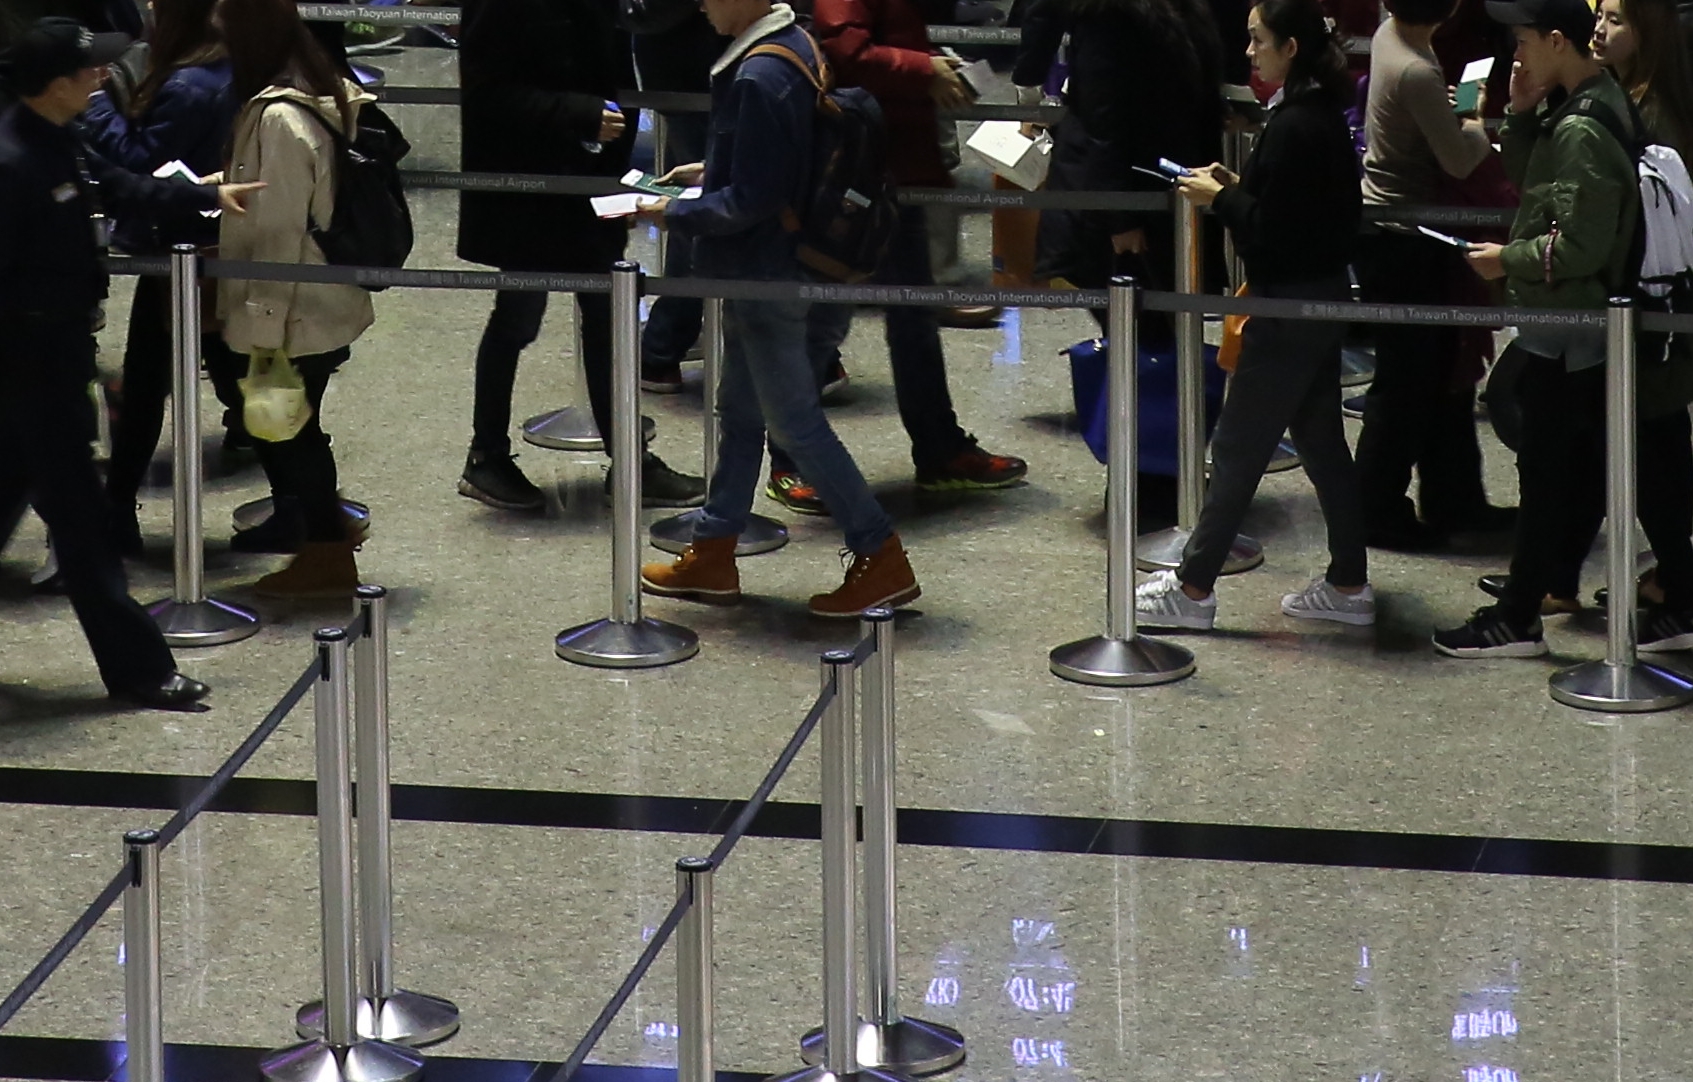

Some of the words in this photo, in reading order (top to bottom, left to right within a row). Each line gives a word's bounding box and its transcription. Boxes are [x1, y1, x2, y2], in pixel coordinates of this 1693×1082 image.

[320, 6, 355, 19] Taiwan
[358, 8, 400, 22] Taoyuan
[402, 9, 460, 22] Internation
[507, 177, 545, 192] Airport
[910, 192, 981, 205] International
[983, 194, 1024, 208] Airport
[1461, 210, 1502, 225] Airport
[130, 261, 171, 273] Interna
[459, 274, 496, 286] Taiwan
[499, 275, 547, 289] Taoyuan
[549, 276, 612, 289] Internation
[904, 289, 944, 301] Taiwan
[947, 290, 996, 305] Taoyuan
[999, 292, 1073, 305] International
[1076, 294, 1108, 308] Airpo
[1408, 308, 1448, 322] Taiwan
[1452, 309, 1500, 325] Taoyuan
[1504, 311, 1580, 326] International
[1582, 314, 1607, 328] Airp
